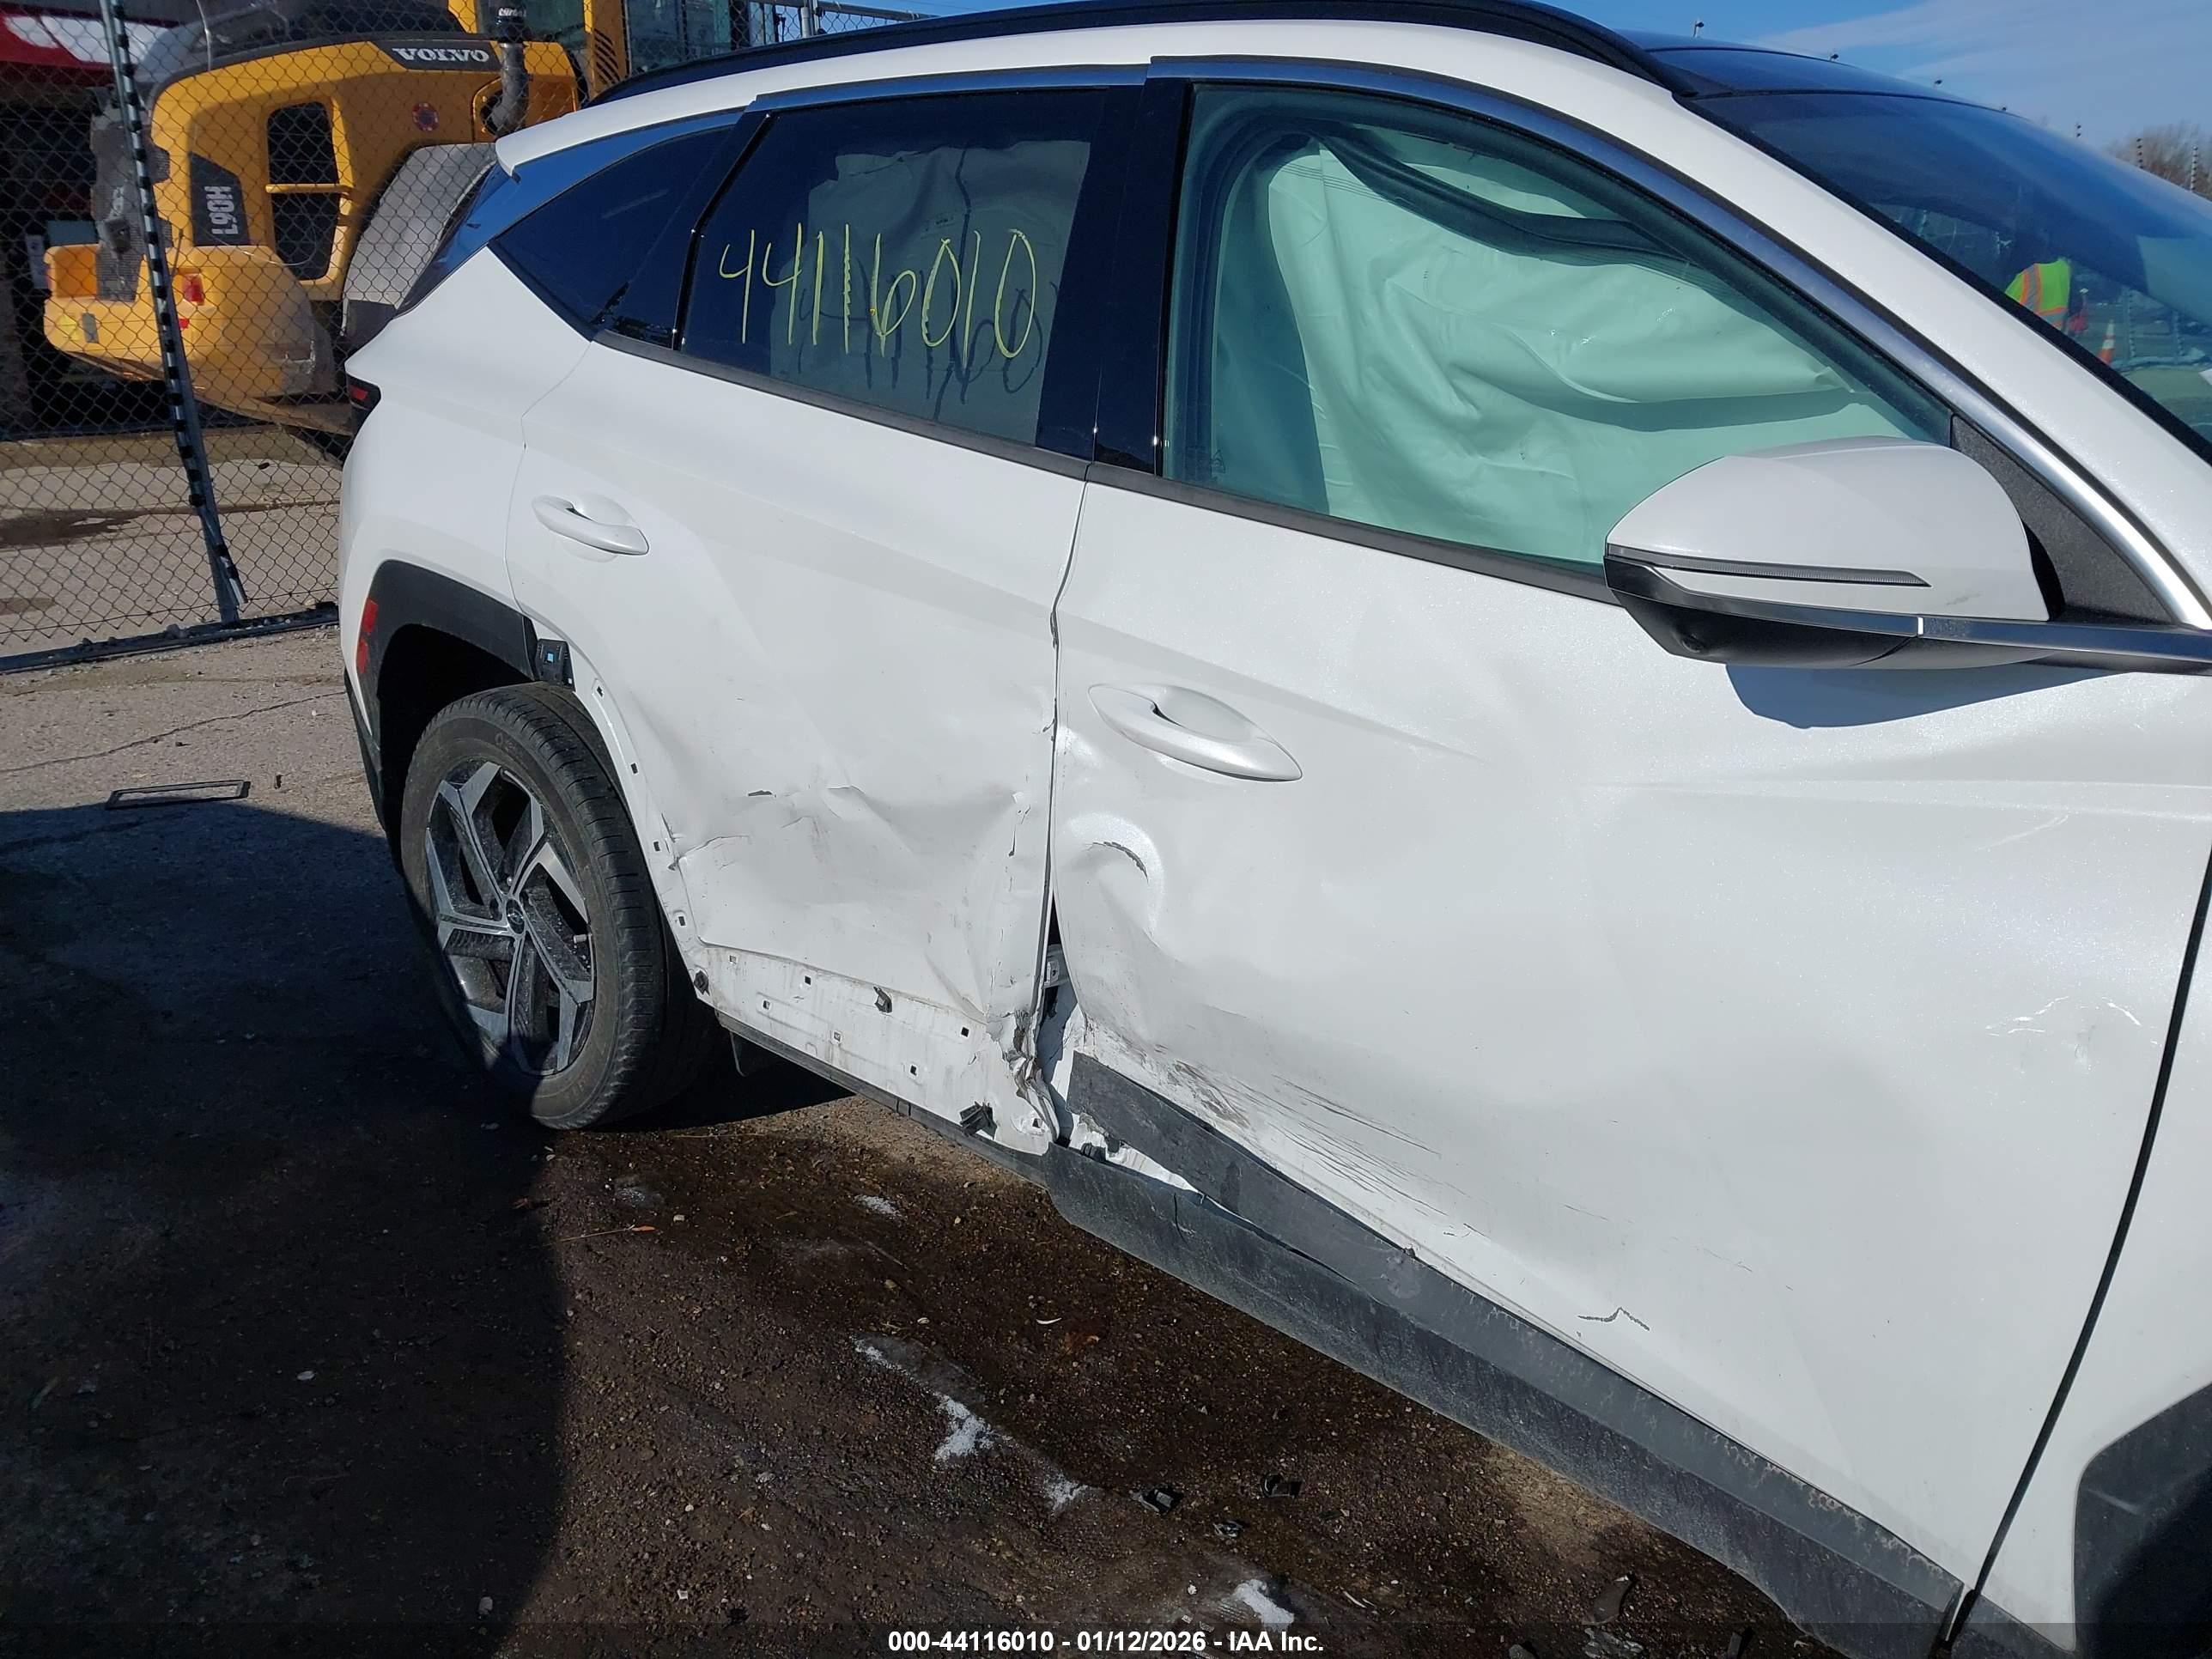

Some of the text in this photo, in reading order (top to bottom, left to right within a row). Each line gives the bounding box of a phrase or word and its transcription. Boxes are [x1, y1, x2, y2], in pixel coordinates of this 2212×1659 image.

[392, 47, 489, 63] VOLVO
[204, 185, 239, 234] L90H
[719, 222, 1036, 369] 44116010
